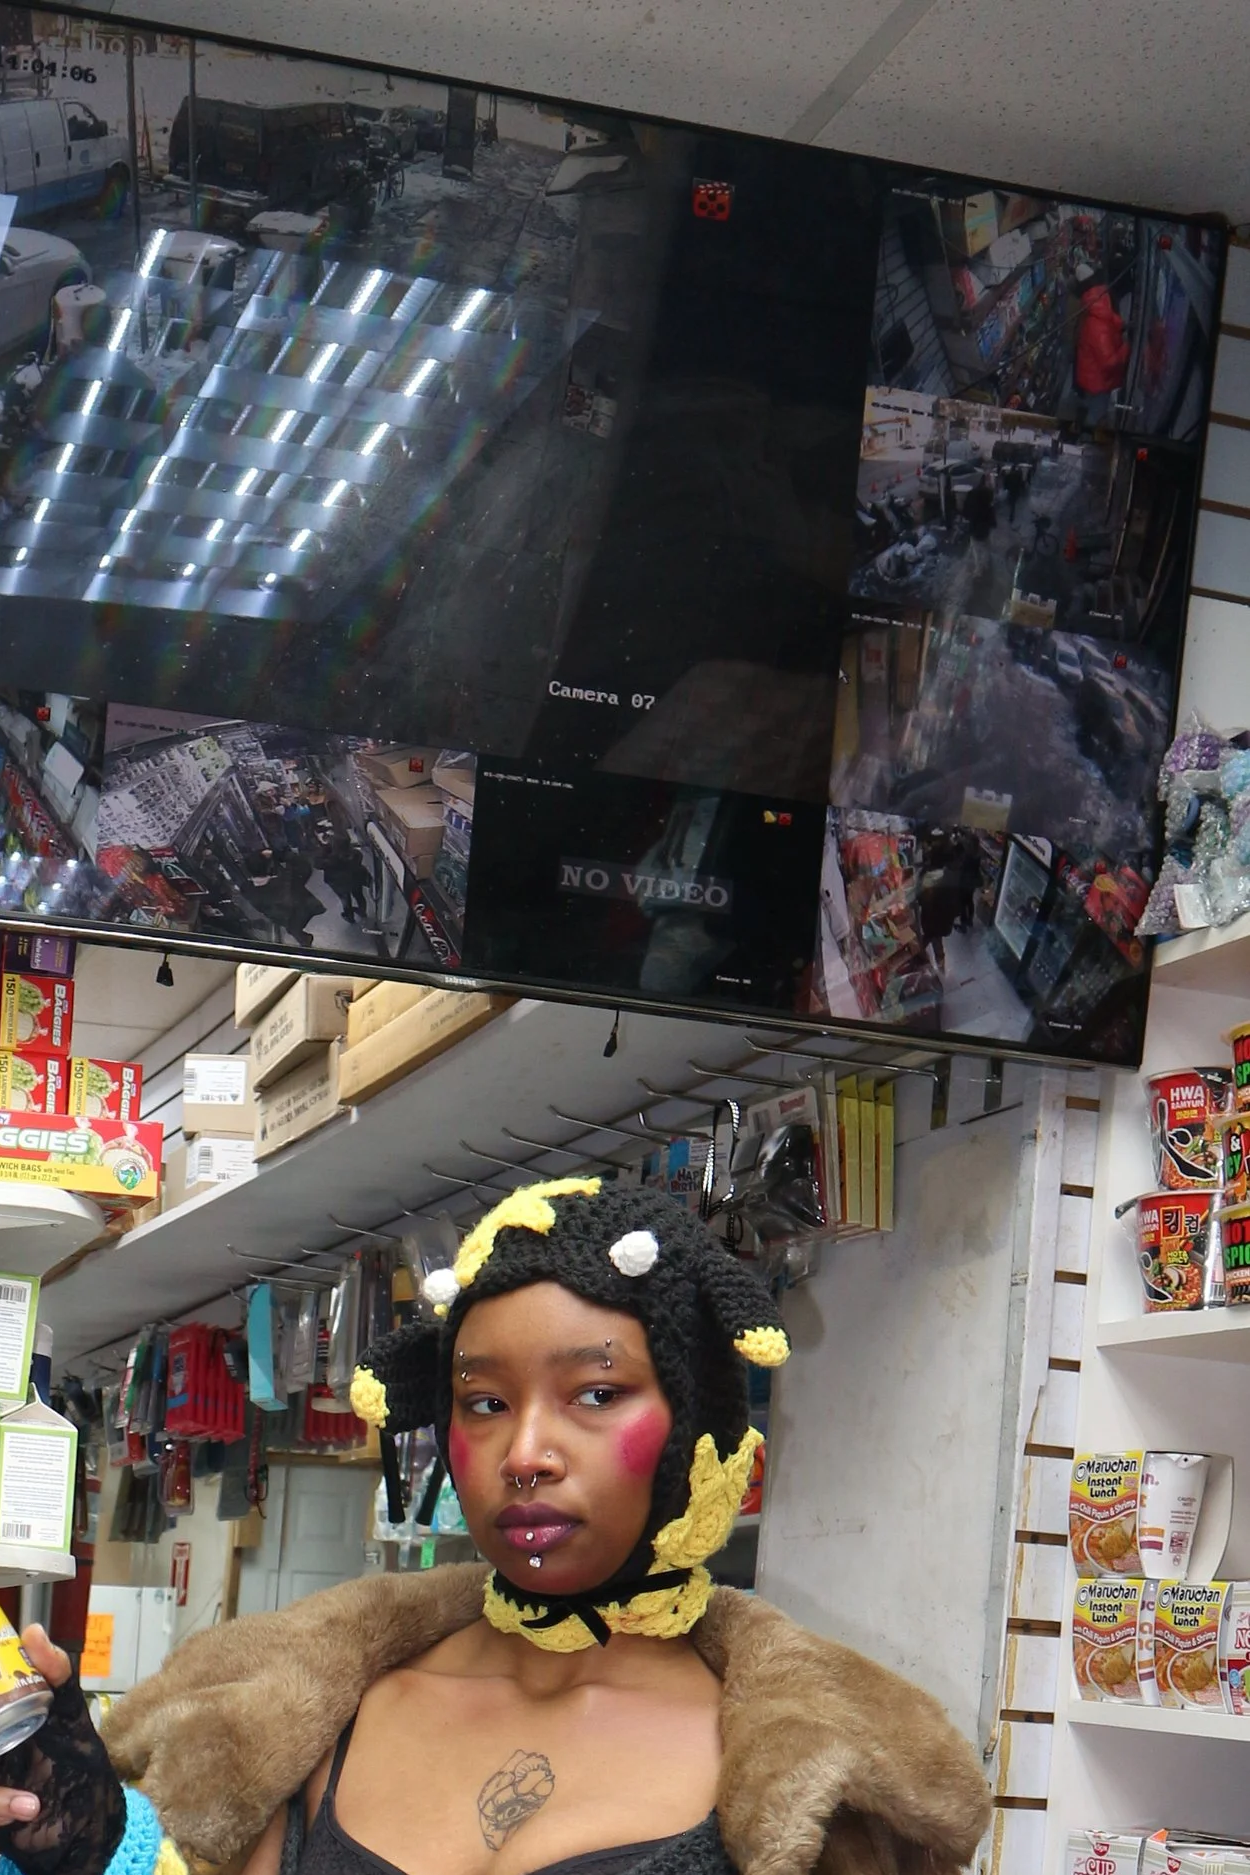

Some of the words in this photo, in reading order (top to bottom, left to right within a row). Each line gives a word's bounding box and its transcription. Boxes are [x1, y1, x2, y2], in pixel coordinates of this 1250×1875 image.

[549, 680, 620, 706] Camera
[631, 692, 656, 710] 07
[561, 864, 609, 890] NO
[622, 873, 728, 907] VIDEO
[6, 977, 16, 995] 150
[52, 984, 67, 1047] BAGGIES
[75, 1060, 84, 1079] 150
[1170, 1085, 1205, 1101] HWA
[1170, 1100, 1205, 1109] RAMYUN
[21, 1163, 42, 1173] BAGS
[1163, 1210, 1200, 1236] 킹컵
[1086, 1459, 1137, 1474] Maruchan
[1087, 1476, 1122, 1487] Instant
[1090, 1488, 1117, 1498] Lunch
[1079, 1502, 1092, 1515] Chili
[1109, 1508, 1115, 1516] &
[1115, 1500, 1136, 1513] Shrimp
[1088, 1584, 1137, 1599] Maruchan
[1171, 1587, 1220, 1603] Maruchan
[1089, 1601, 1122, 1612] Instant
[1171, 1605, 1204, 1616] Instant
[1092, 1612, 1117, 1623] Lunch
[1173, 1616, 1199, 1627] Lunch
